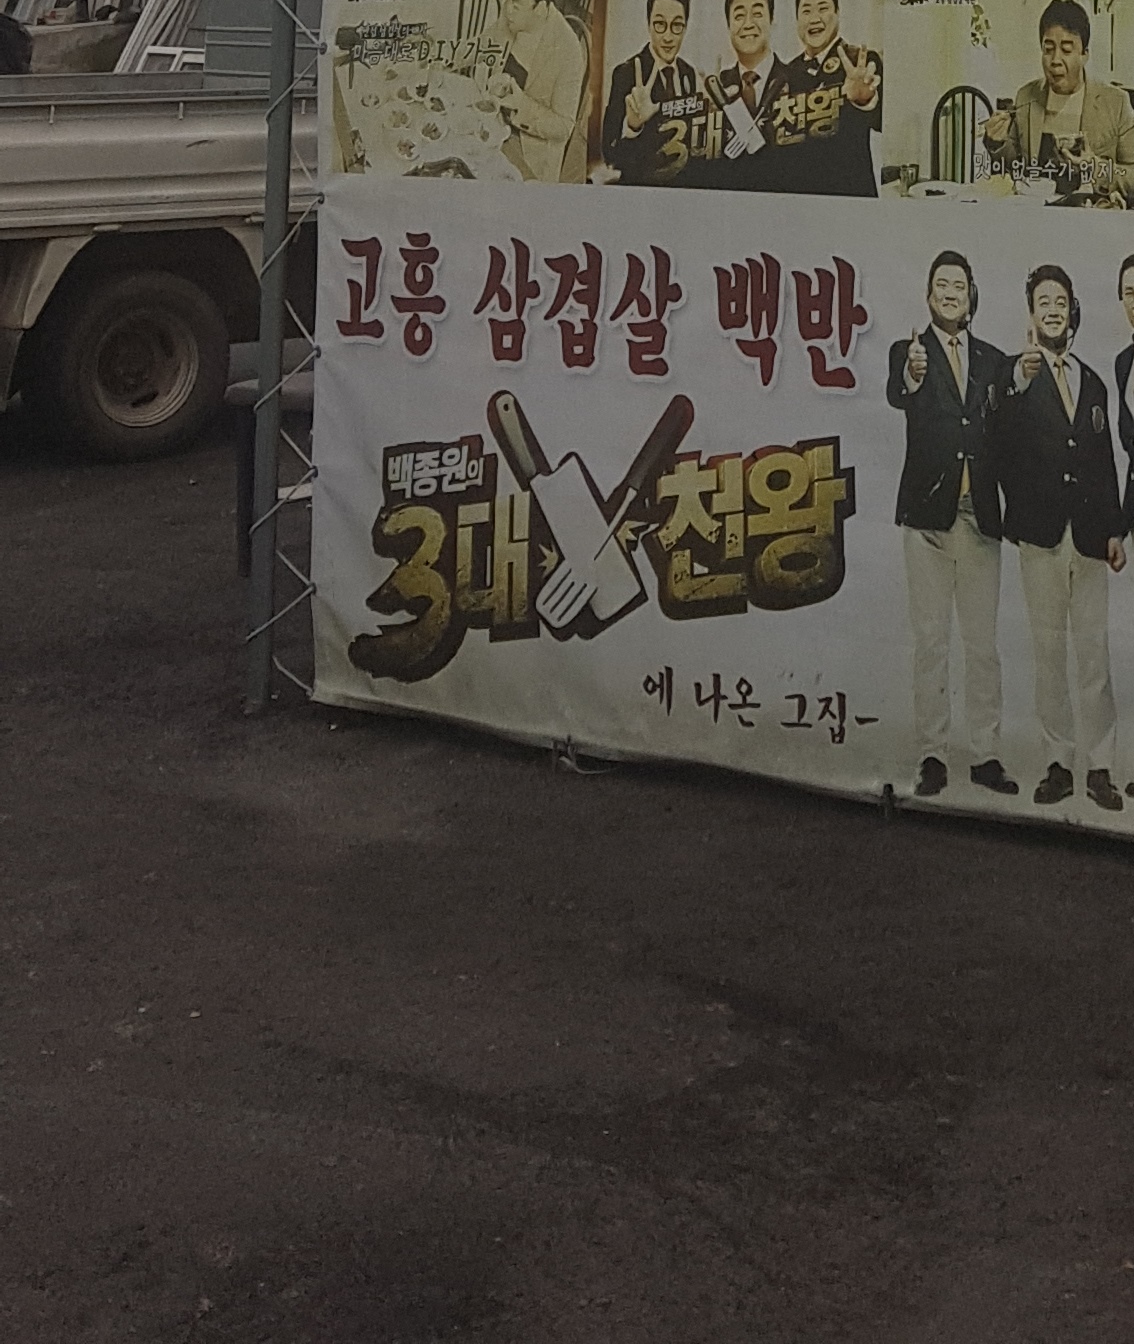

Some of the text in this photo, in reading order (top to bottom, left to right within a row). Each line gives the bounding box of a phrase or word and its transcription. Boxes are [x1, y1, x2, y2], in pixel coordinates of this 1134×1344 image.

[352, 39, 414, 65] 마음대로
[463, 37, 511, 67] 가능!
[661, 95, 705, 118] 백종원의
[974, 150, 1006, 182] 맛이
[336, 232, 868, 389] 고흥 삼겹살 백반
[386, 444, 484, 499] 백종원의
[655, 443, 847, 604] 천왕
[642, 666, 674, 716] 에
[693, 673, 761, 727] 나온
